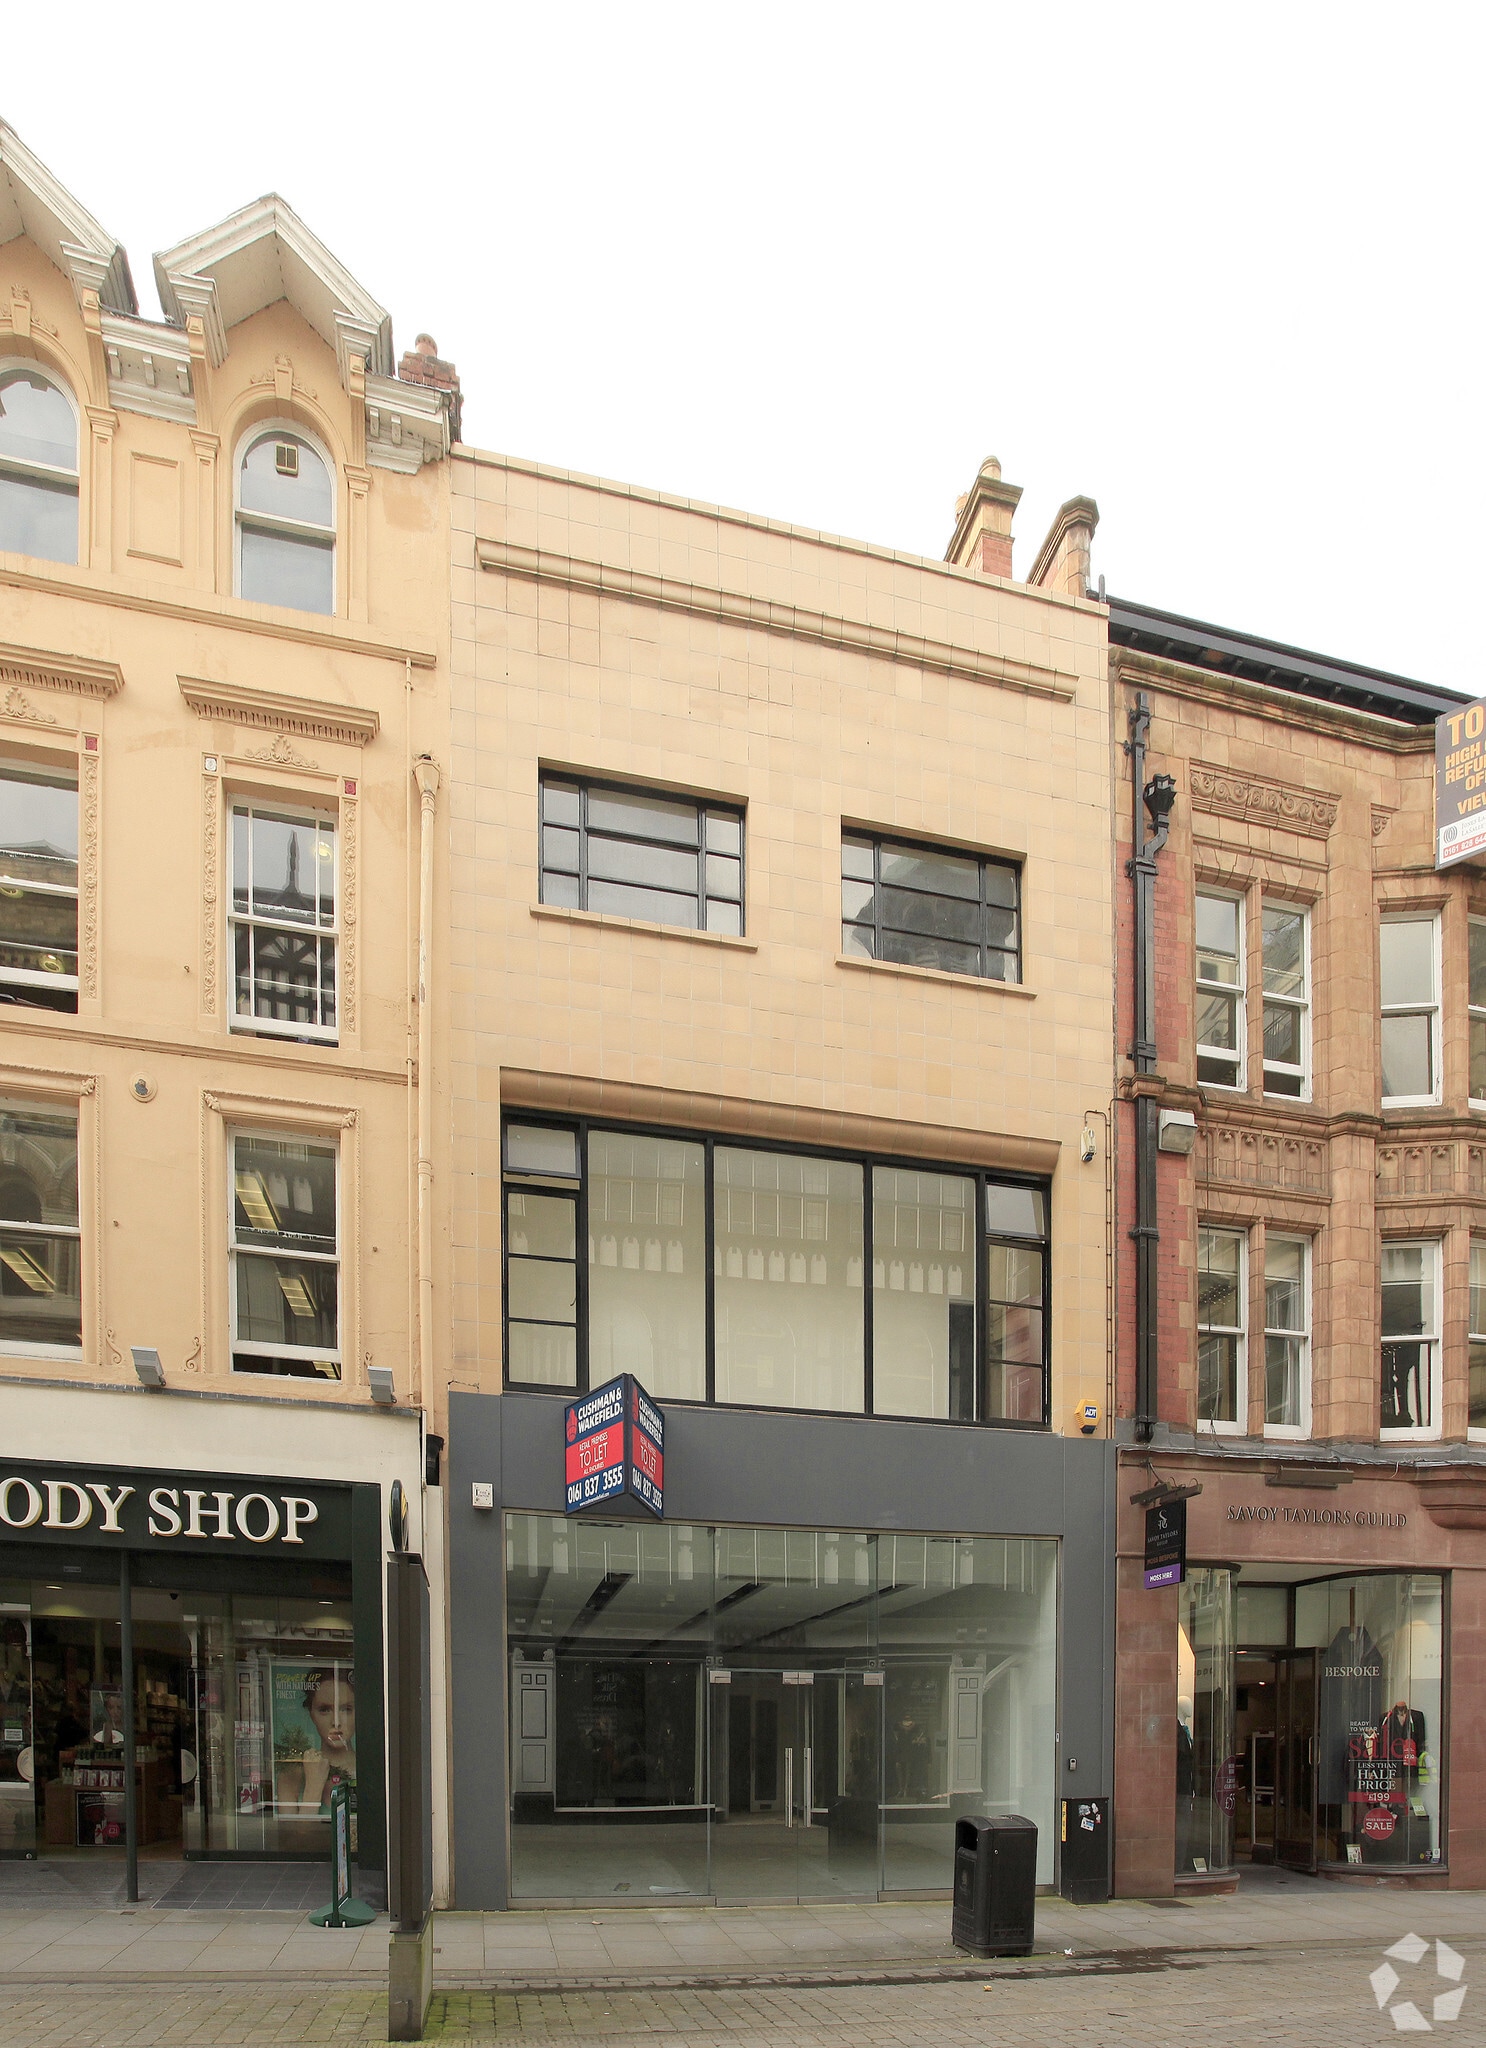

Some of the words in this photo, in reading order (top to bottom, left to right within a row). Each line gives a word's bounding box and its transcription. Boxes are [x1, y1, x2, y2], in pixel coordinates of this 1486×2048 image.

[1447, 705, 1484, 747] TO
[1445, 741, 1481, 770] HIGH
[1465, 771, 1486, 791] OF
[1444, 845, 1459, 857] 0161
[578, 1389, 616, 1421] CUSHMAN
[616, 1387, 622, 1401] &
[1085, 1408, 1096, 1417] ADT
[579, 1450, 591, 1468] TO
[594, 1442, 608, 1462] LET
[640, 1445, 648, 1465] TO
[648, 1453, 657, 1474] LET
[567, 1482, 582, 1504] 0161
[584, 1474, 599, 1497] 837
[602, 1465, 623, 1490] 3555
[0, 1476, 136, 1533] ODY
[147, 1487, 319, 1544] SHOP
[1227, 1505, 1279, 1522] SAVOY
[1281, 1507, 1351, 1525] TAYLORS
[1353, 1511, 1407, 1528] GUILD
[1149, 1573, 1161, 1583] MOSS
[1325, 1665, 1380, 1677] BESPOKE
[308, 1673, 322, 1682] UP
[275, 1681, 292, 1690] WITH
[276, 1690, 296, 1699] FINEST
[1357, 1769, 1397, 1780] HALF
[1357, 1780, 1397, 1790] PRICE
[1368, 1792, 1390, 1802] £199
[1366, 1821, 1393, 1831] SALE
